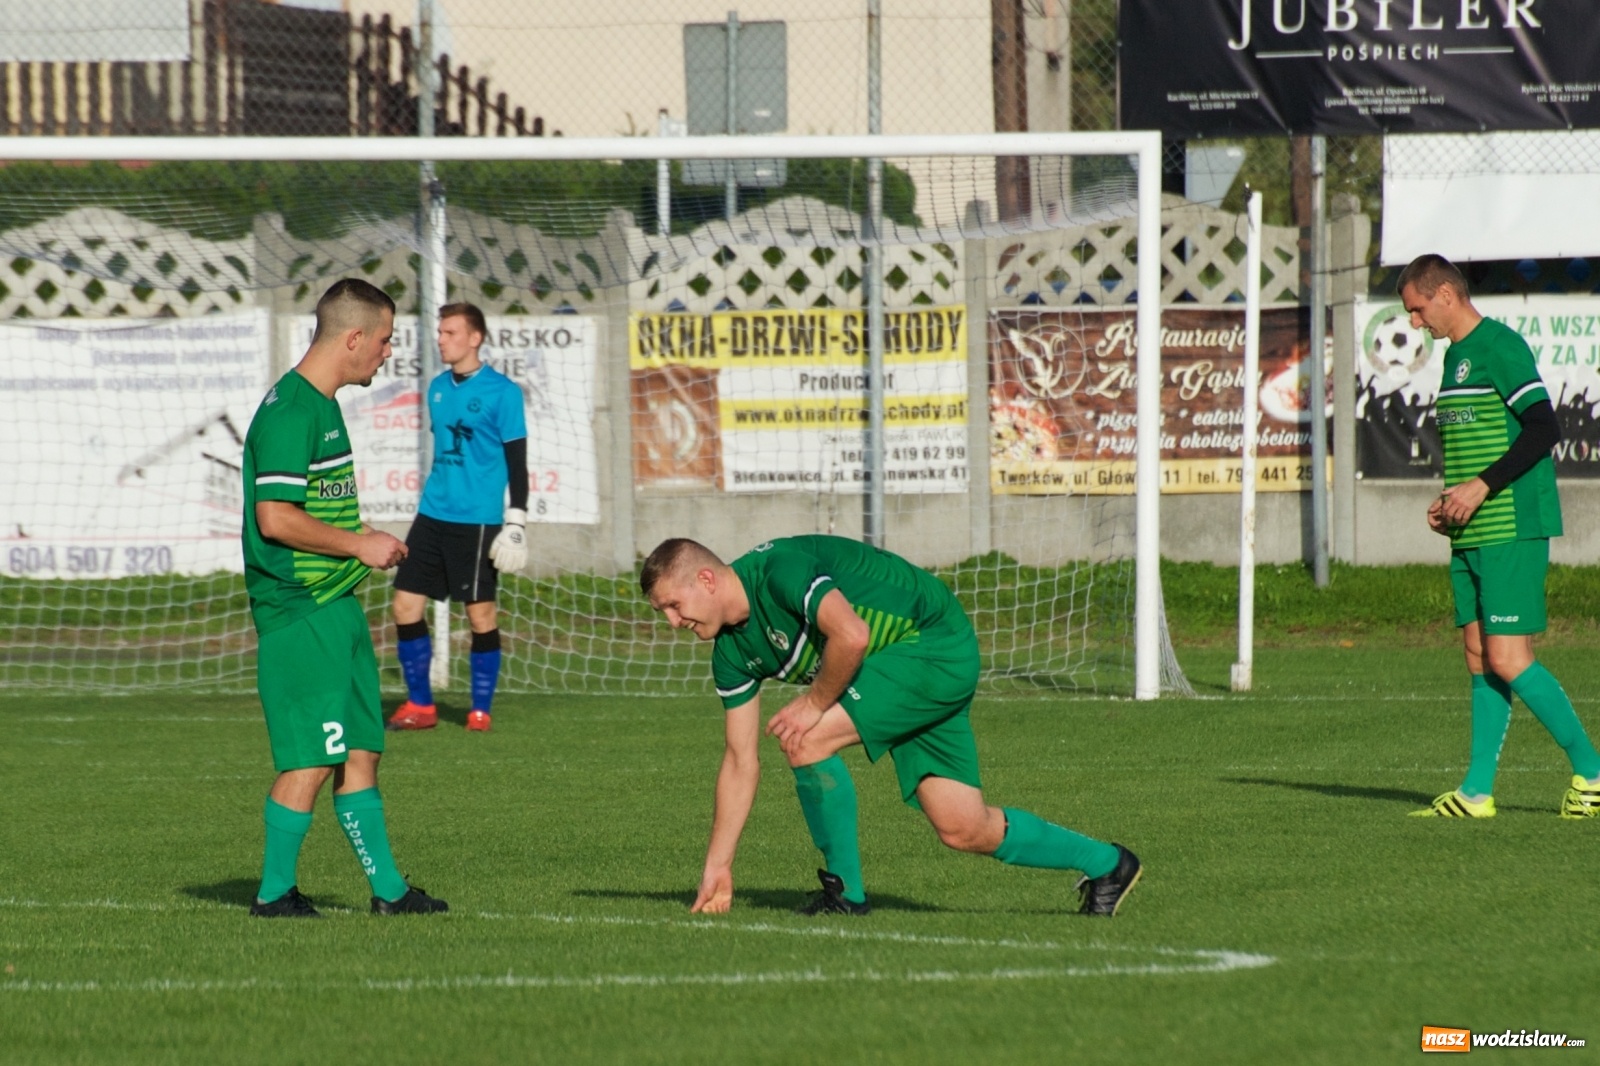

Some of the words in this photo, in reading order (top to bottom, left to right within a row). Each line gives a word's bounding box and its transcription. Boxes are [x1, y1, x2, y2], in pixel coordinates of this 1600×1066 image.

[1327, 43, 1439, 61] POŚPIECH
[1517, 316, 1541, 336] ZA
[485, 328, 583, 348] ARSKO-
[1551, 345, 1577, 365] ZA
[386, 469, 421, 491] 66
[529, 471, 559, 492] 12
[1098, 470, 1137, 486] Głów
[1198, 470, 1220, 484] tel.
[1226, 467, 1243, 483] 79
[1261, 466, 1287, 482] 441
[1296, 466, 1313, 481] 25
[9, 546, 57, 574] 604
[67, 545, 115, 574] 507
[124, 545, 173, 574] 320
[322, 721, 346, 755] 2
